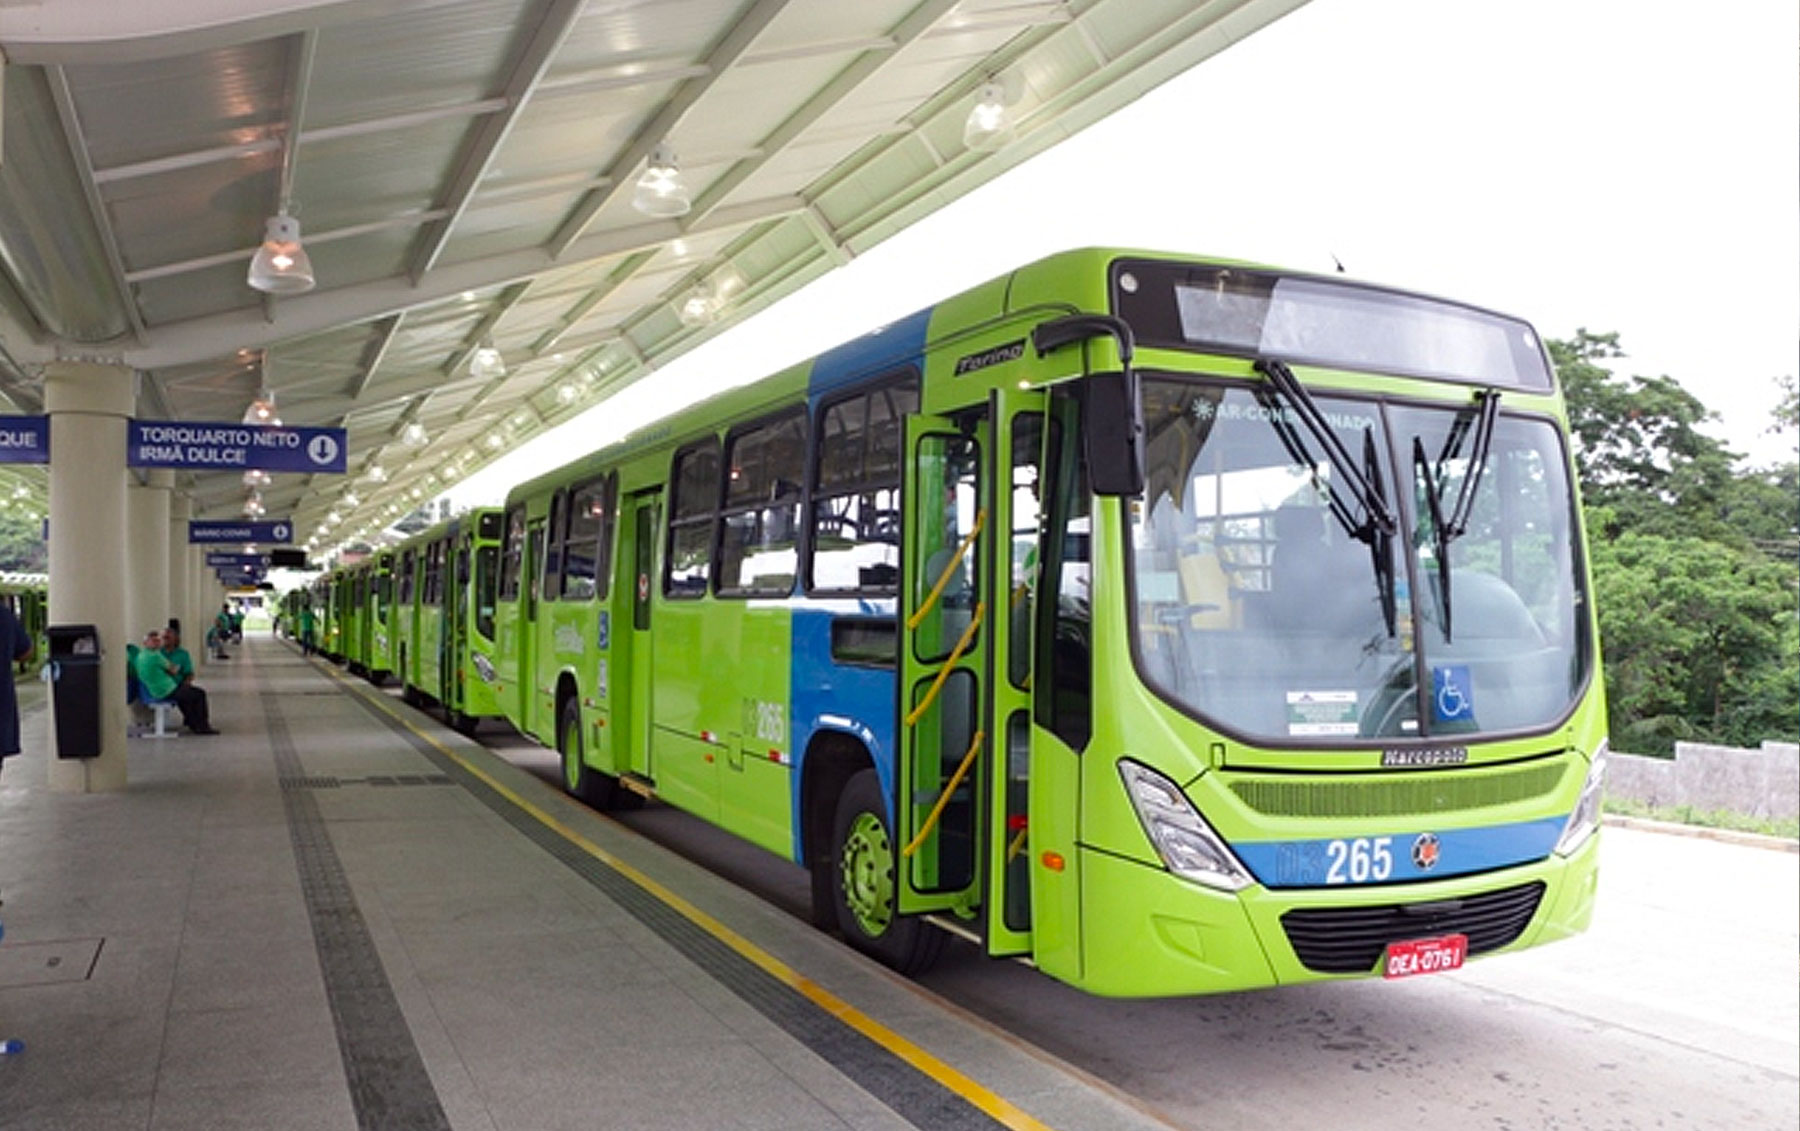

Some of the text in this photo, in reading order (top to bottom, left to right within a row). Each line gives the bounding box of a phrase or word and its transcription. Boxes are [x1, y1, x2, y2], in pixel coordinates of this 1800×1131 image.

[140, 427, 299, 447] TORQUARTO NETO
[139, 445, 246, 463] IRMÃ DULCE
[1384, 748, 1465, 764] Marcopolo
